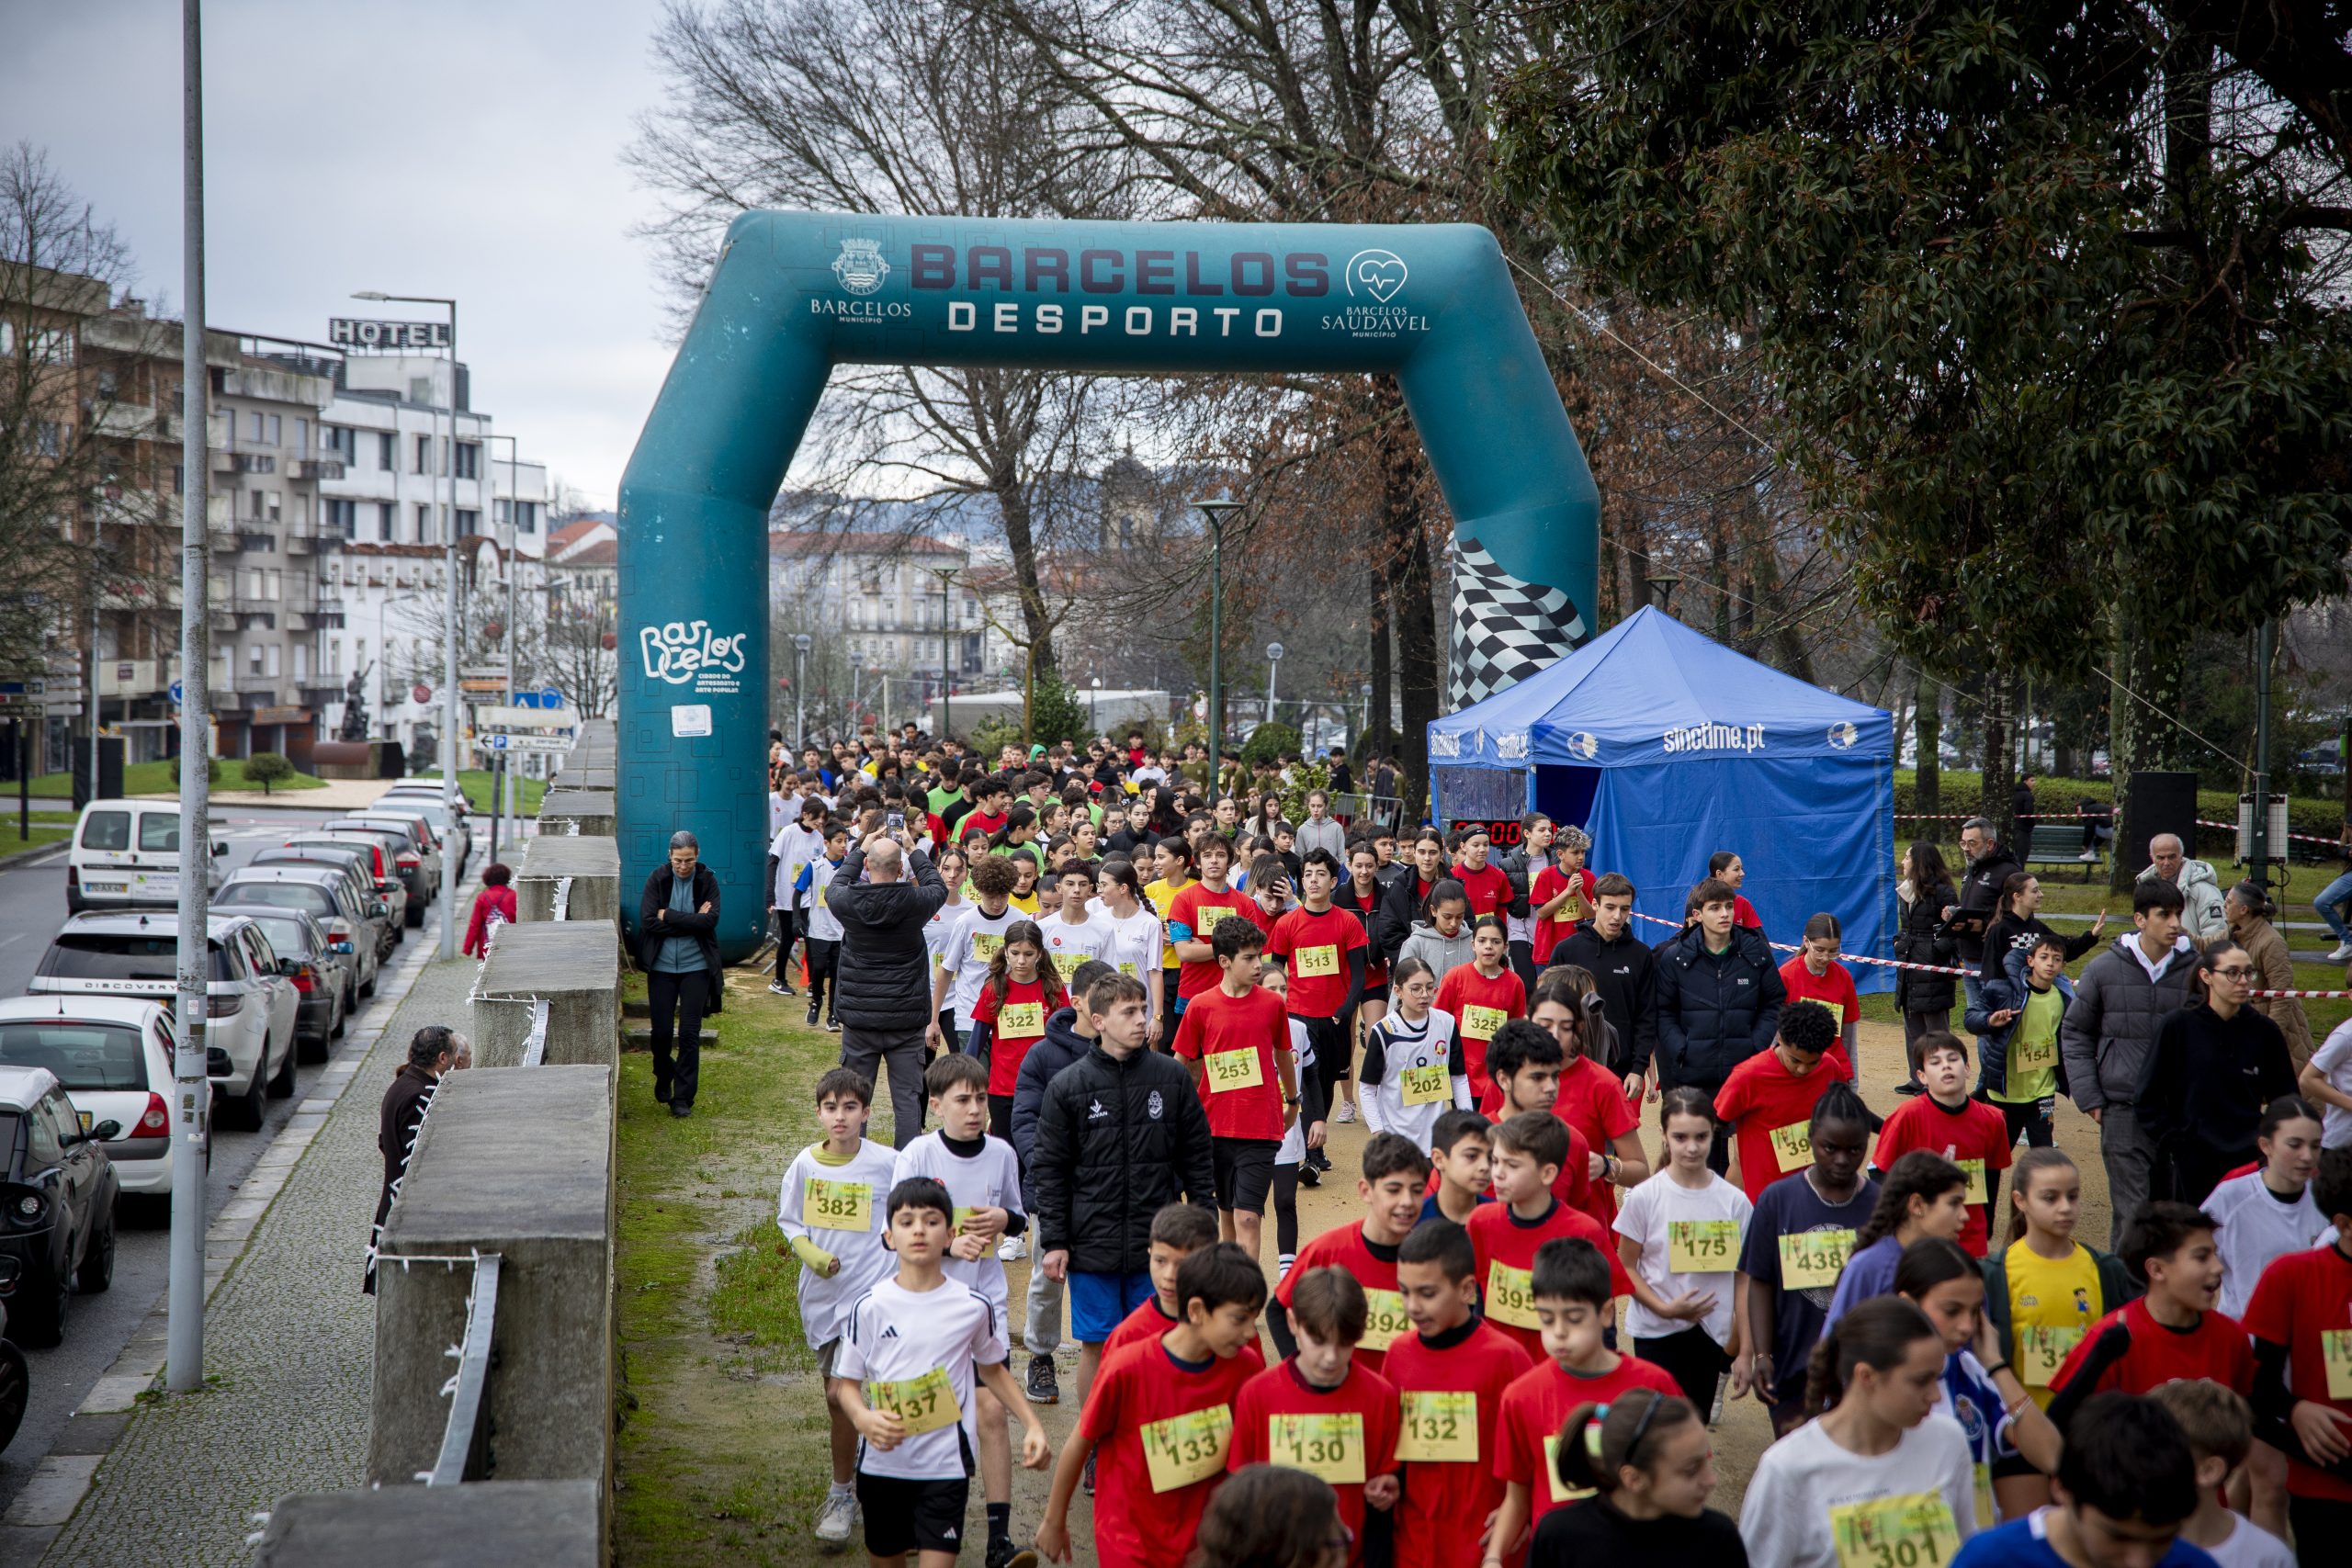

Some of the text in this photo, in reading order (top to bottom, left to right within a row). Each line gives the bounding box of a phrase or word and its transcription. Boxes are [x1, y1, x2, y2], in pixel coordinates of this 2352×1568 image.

[910, 243, 1329, 297] BARCELOS
[811, 299, 911, 317] BARCELOS
[1346, 306, 1408, 316] BARCELOS
[948, 301, 1283, 337] DESPORTO
[1321, 315, 1431, 331] SAUDÁVEL
[332, 321, 449, 346] HOTEL
[1663, 720, 1766, 754] sinctime.pt
[1559, 904, 1579, 915] 247
[1058, 964, 1074, 975] 38
[1306, 956, 1330, 968] 513
[85, 982, 178, 990] DISCOVERY
[1006, 1014, 1035, 1028] 322
[1471, 1017, 1498, 1032] 325
[2025, 1050, 2051, 1063] 154
[1218, 1063, 1250, 1080] 253
[1412, 1077, 1442, 1094] 202
[1786, 1137, 1811, 1156] 39
[817, 1197, 858, 1217] 382
[1684, 1239, 1727, 1258] 175
[1797, 1251, 1843, 1271] 438
[890, 1393, 937, 1421] 137
[1408, 1418, 1459, 1440] 132
[1166, 1434, 1218, 1466] 133
[1291, 1440, 1345, 1463] 130
[1868, 1535, 1939, 1568] 301
